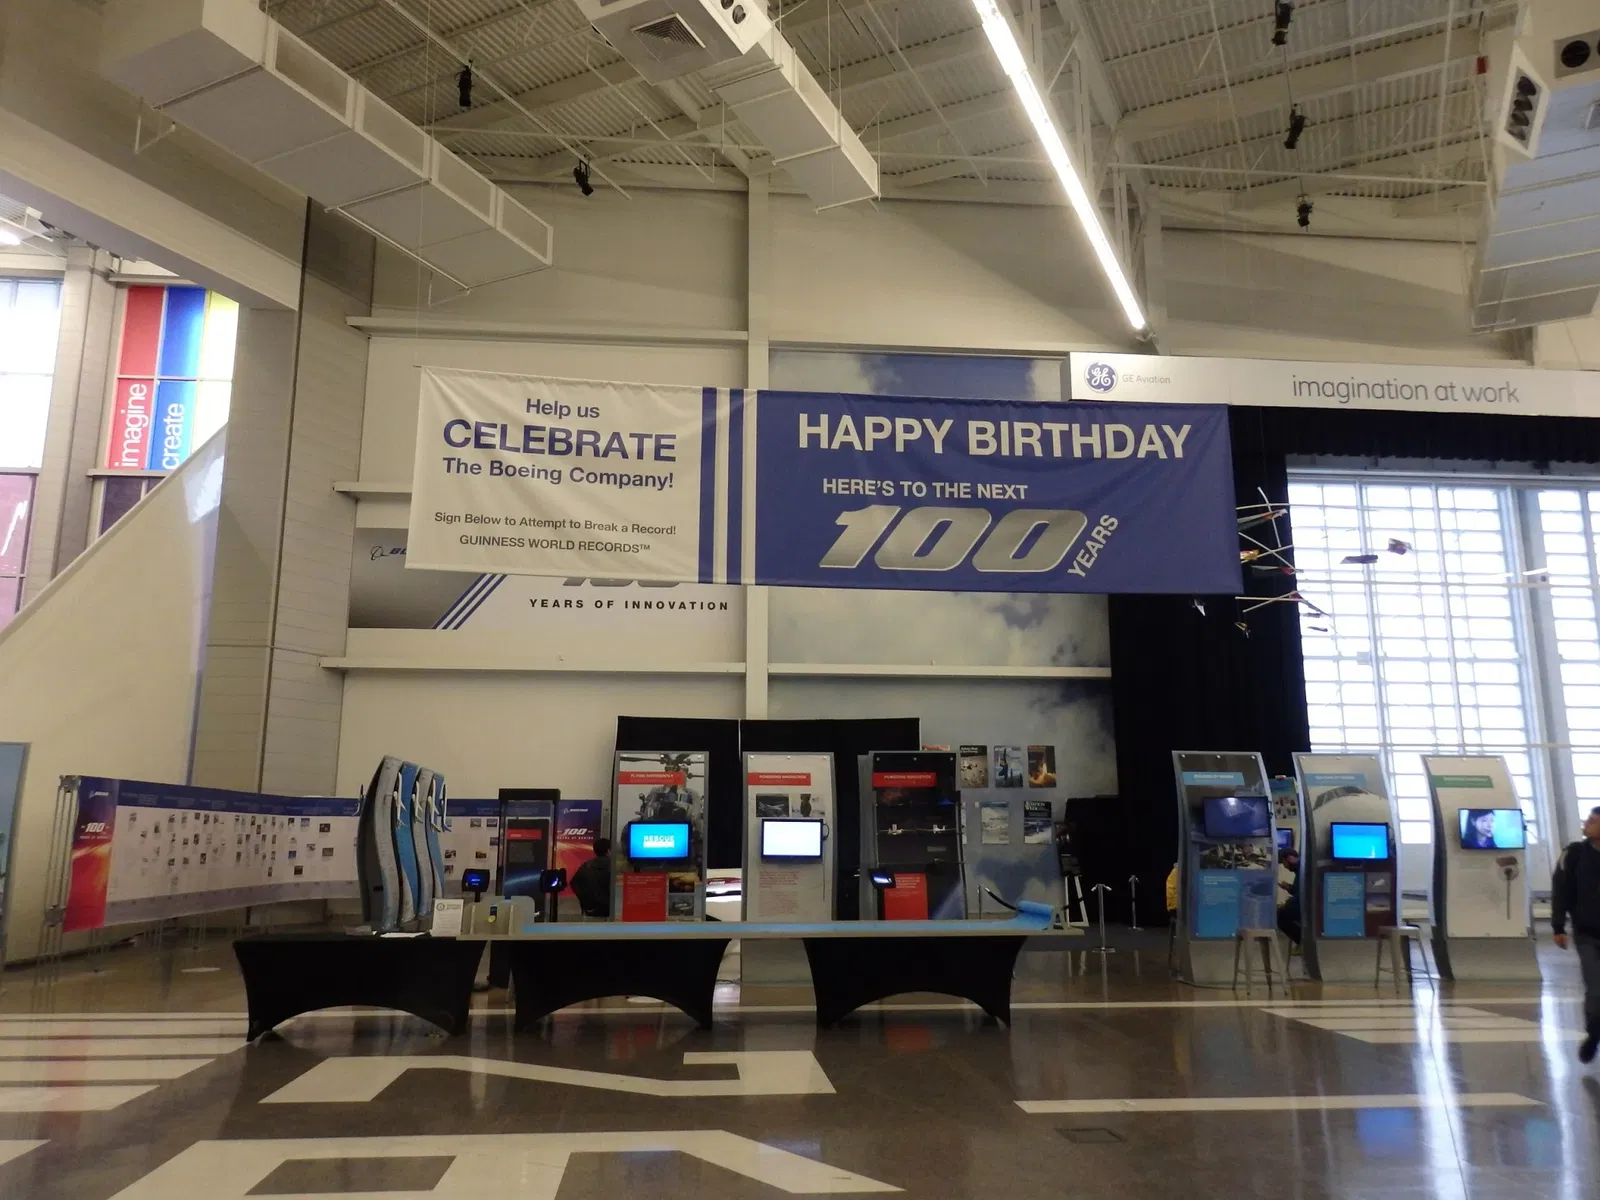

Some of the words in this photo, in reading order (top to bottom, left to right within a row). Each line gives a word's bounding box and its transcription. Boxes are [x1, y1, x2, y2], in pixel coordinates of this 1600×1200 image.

[1122, 374, 1135, 383] GE
[1136, 375, 1171, 384] Aviation
[1292, 374, 1429, 404] imagination
[1434, 383, 1459, 402] at
[1461, 381, 1520, 404] work
[526, 398, 572, 418] Help
[577, 406, 600, 418] us
[114, 383, 149, 467] imagine
[162, 403, 185, 470] create
[800, 413, 953, 454] HAPPY
[968, 420, 1191, 459] BIRTHDAY
[443, 418, 677, 463] CELEBRATE
[442, 457, 482, 475] The
[489, 460, 562, 485] Boeing
[569, 466, 674, 491] Company!
[823, 478, 895, 497] HERE'S
[900, 481, 927, 498] TO
[932, 482, 971, 499] THE
[977, 483, 1028, 500] NEXT
[434, 512, 461, 525] Sign
[464, 513, 501, 526] Below
[504, 516, 517, 526] to
[519, 516, 566, 531] Attempt
[569, 519, 581, 529] to
[584, 520, 618, 532] Break
[621, 525, 628, 533] a
[631, 524, 676, 535] Record!
[819, 504, 1088, 573] 100
[459, 535, 525, 547] GUINNESS
[528, 538, 575, 550] WORLD
[1067, 514, 1120, 579] YEARS
[529, 599, 584, 608] YEARS
[594, 600, 614, 609] OF
[624, 600, 729, 611] INNOVATION
[85, 822, 105, 833] 100
